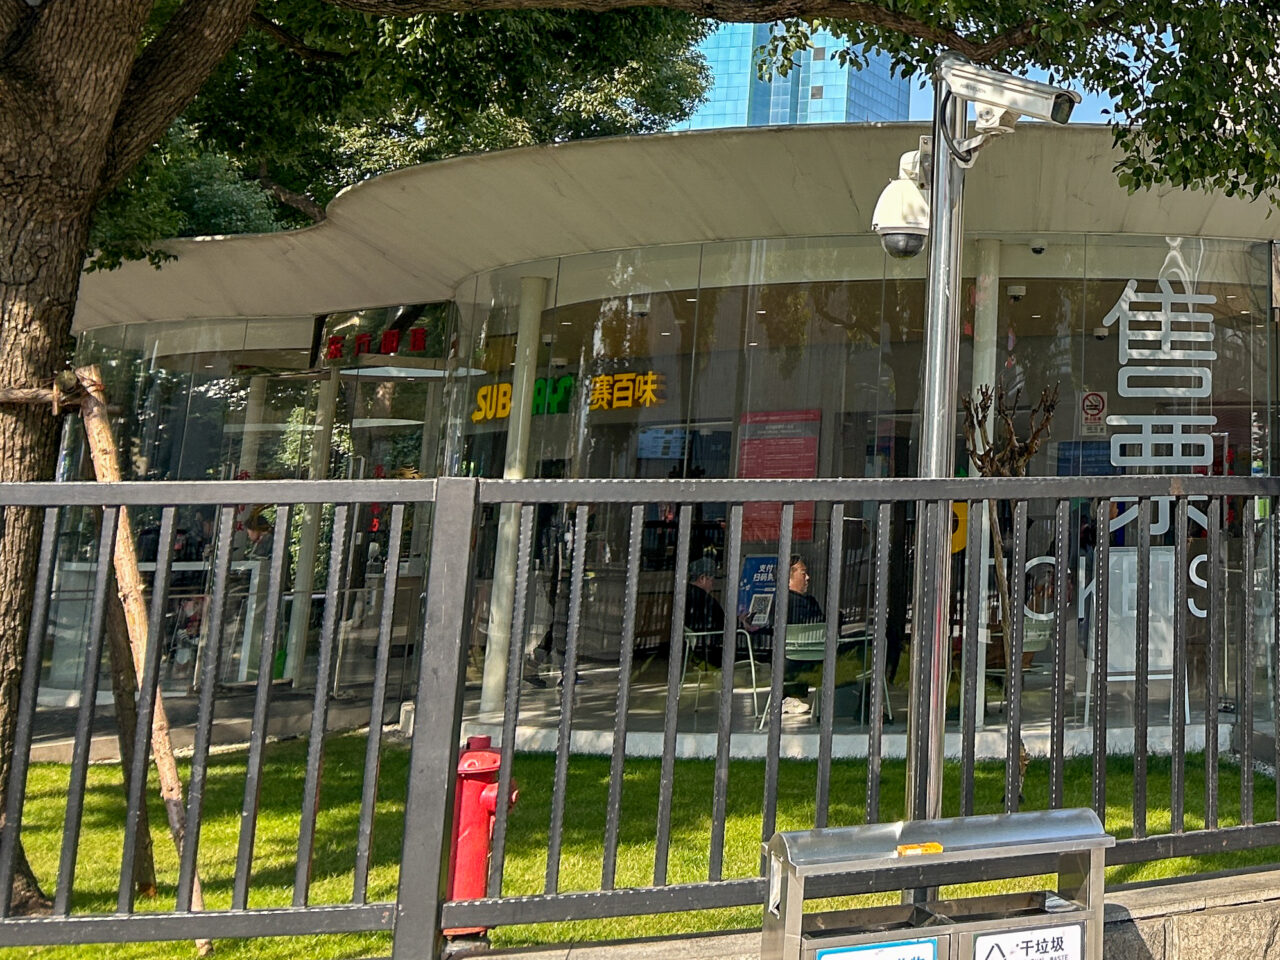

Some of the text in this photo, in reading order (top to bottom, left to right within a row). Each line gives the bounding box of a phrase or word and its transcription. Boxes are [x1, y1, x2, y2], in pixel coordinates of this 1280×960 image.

[472, 373, 575, 423] SUBAY
[590, 371, 659, 410] 赛百味
[1020, 936, 1065, 957] 干垃圾
